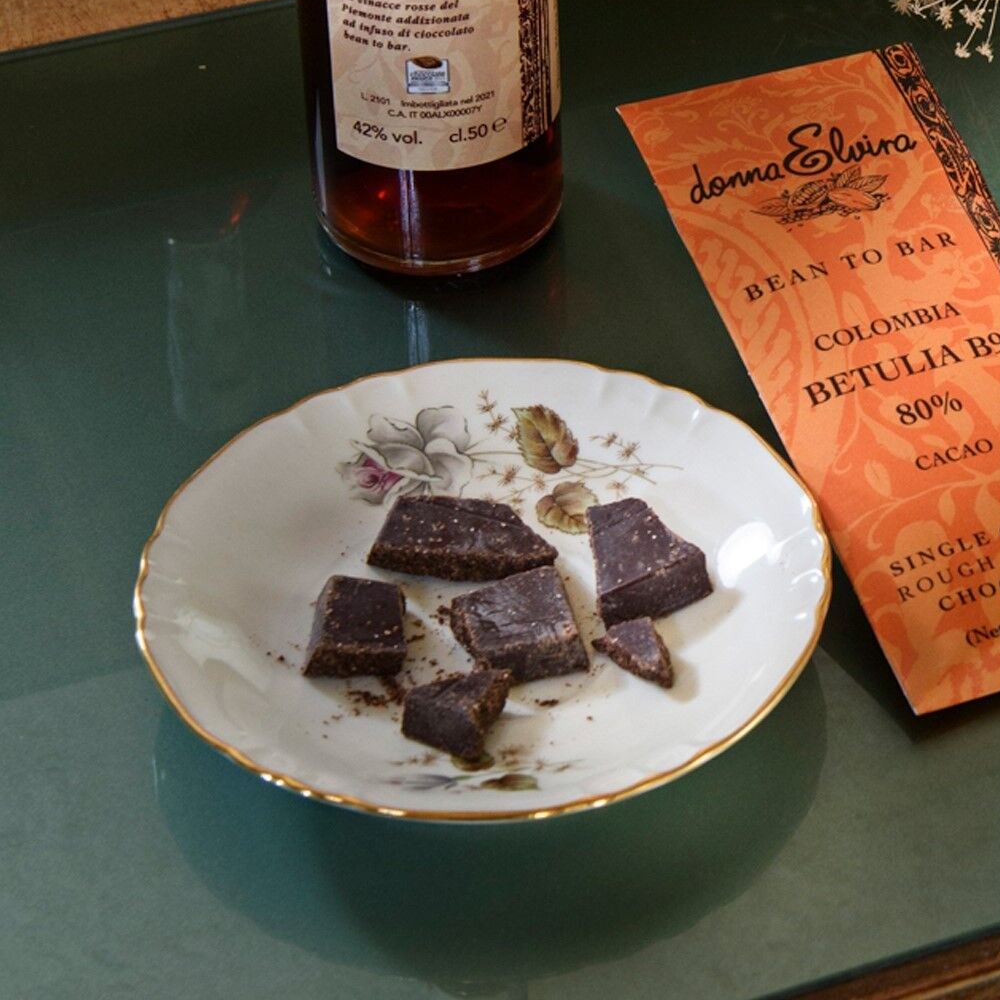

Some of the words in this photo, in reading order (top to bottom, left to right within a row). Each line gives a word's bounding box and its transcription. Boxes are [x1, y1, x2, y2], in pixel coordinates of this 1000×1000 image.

[342, 4, 392, 23] Piemonte
[396, 12, 470, 25] addizionata
[440, 0, 459, 10] del
[343, 18, 355, 28] ad
[360, 23, 393, 36] infuso
[398, 29, 410, 37] di
[414, 25, 475, 38] cioccolato
[344, 31, 369, 45] bean
[372, 39, 383, 48] to
[387, 41, 410, 51] bar.
[401, 99, 458, 109] Imbottigliata
[460, 96, 474, 104] nel
[353, 121, 388, 141] 42%
[392, 131, 422, 144] vol.
[689, 161, 786, 204] donna
[783, 122, 918, 176] Elvira
[743, 261, 831, 302] BEAN
[840, 248, 883, 271] TO
[894, 231, 957, 257] BAR
[813, 301, 961, 352] COLOMBIA
[802, 343, 963, 408] BETULIA
[895, 391, 963, 426] 80%
[914, 438, 994, 471] CACAO
[888, 531, 992, 578] SINGLE
[896, 556, 996, 602] ROUGH
